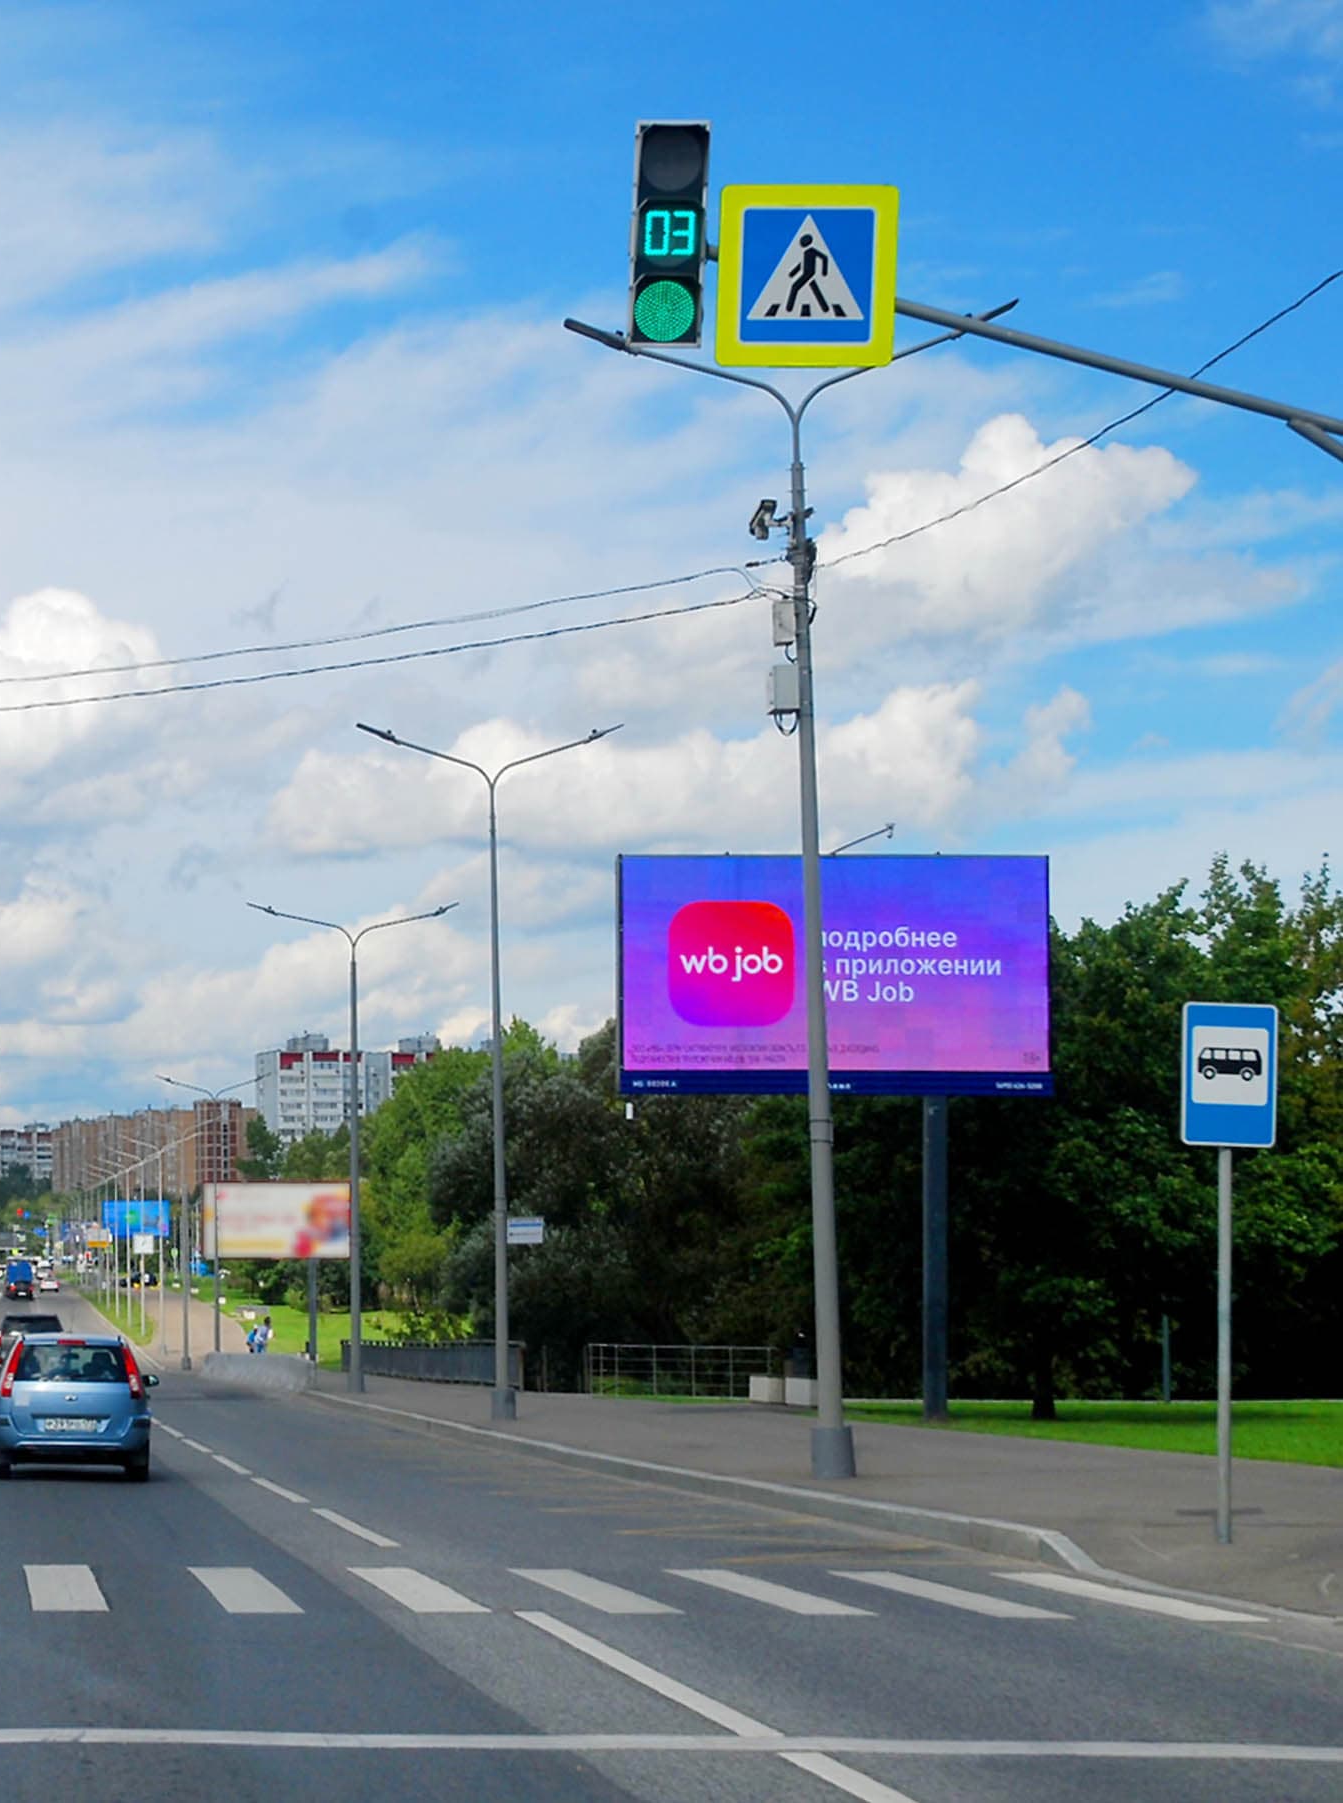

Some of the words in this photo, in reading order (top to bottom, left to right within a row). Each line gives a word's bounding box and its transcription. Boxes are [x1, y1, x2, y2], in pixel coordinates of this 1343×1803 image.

[645, 210, 696, 256] 03
[680, 946, 728, 974] wb
[731, 946, 783, 982] job
[836, 956, 1003, 978] приложении
[823, 980, 859, 1002] WB
[867, 981, 915, 1003] Job
